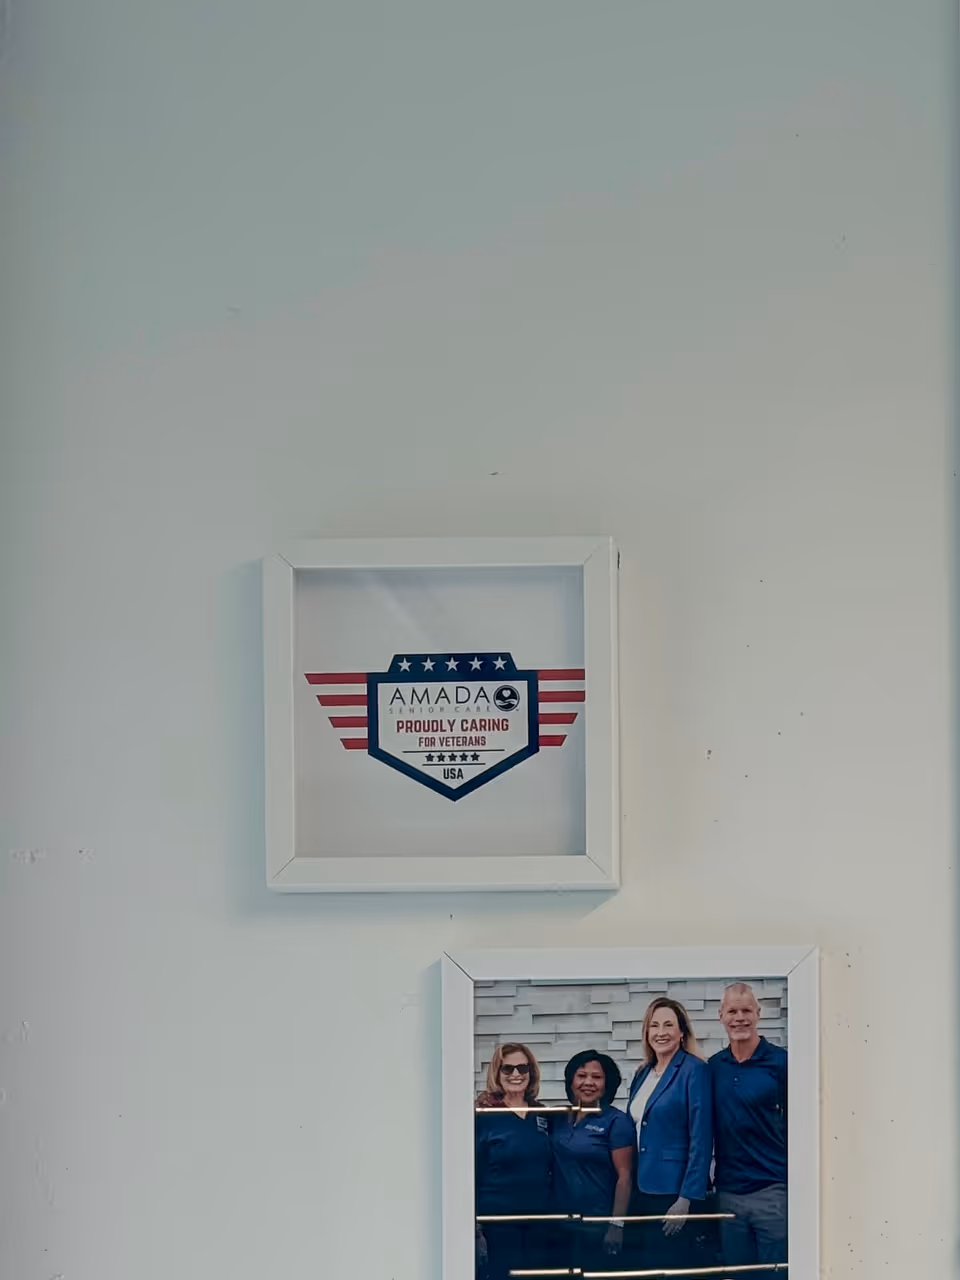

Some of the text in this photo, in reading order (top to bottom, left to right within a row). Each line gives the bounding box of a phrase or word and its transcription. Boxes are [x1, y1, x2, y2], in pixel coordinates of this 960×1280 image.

[389, 686, 491, 705] AMADA
[396, 718, 510, 733] PROUDLY CARING
[418, 735, 486, 748] FOR VETERANS
[443, 768, 464, 780] USA
